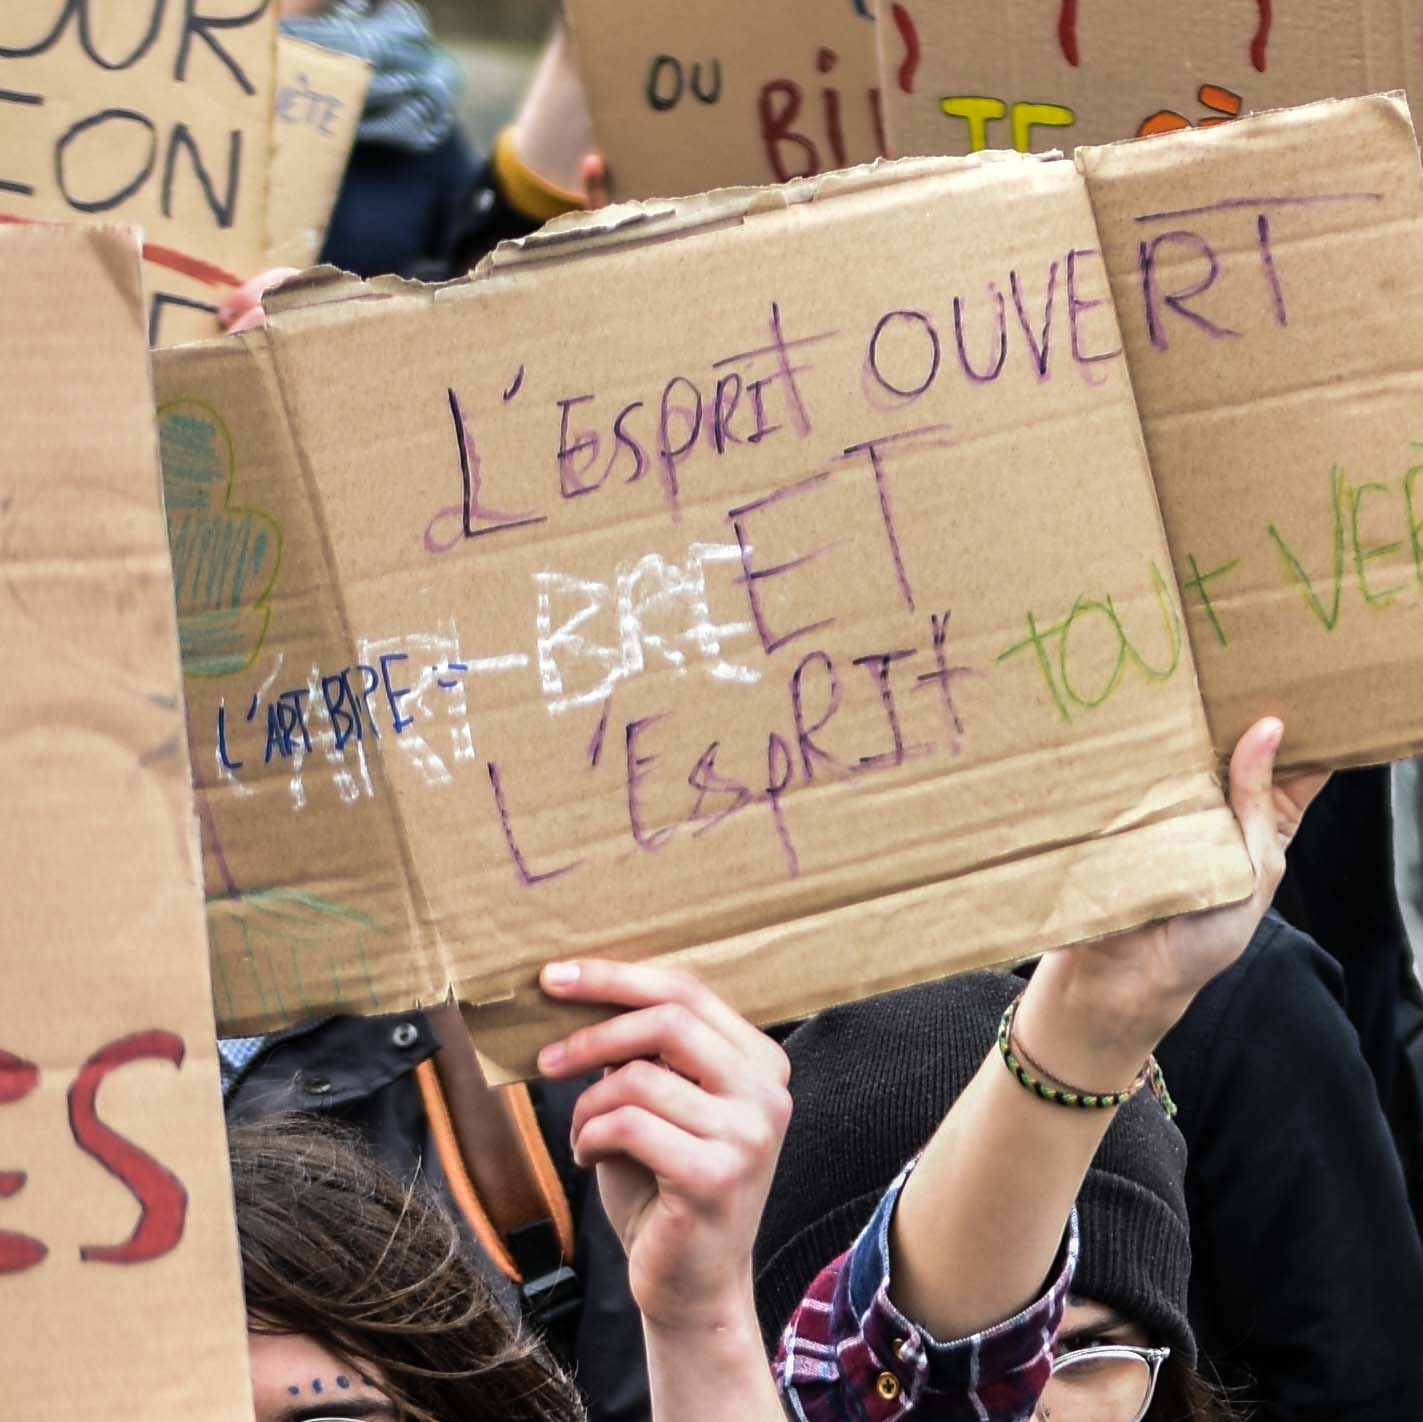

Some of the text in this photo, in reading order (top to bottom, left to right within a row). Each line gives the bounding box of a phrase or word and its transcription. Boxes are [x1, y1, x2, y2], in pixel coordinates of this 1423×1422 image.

[0, 90, 242, 229] ON
[645, 54, 722, 111] OU
[861, 192, 1384, 409] OUVERT
[726, 421, 952, 652] ET
[0, 1029, 188, 1277] S
